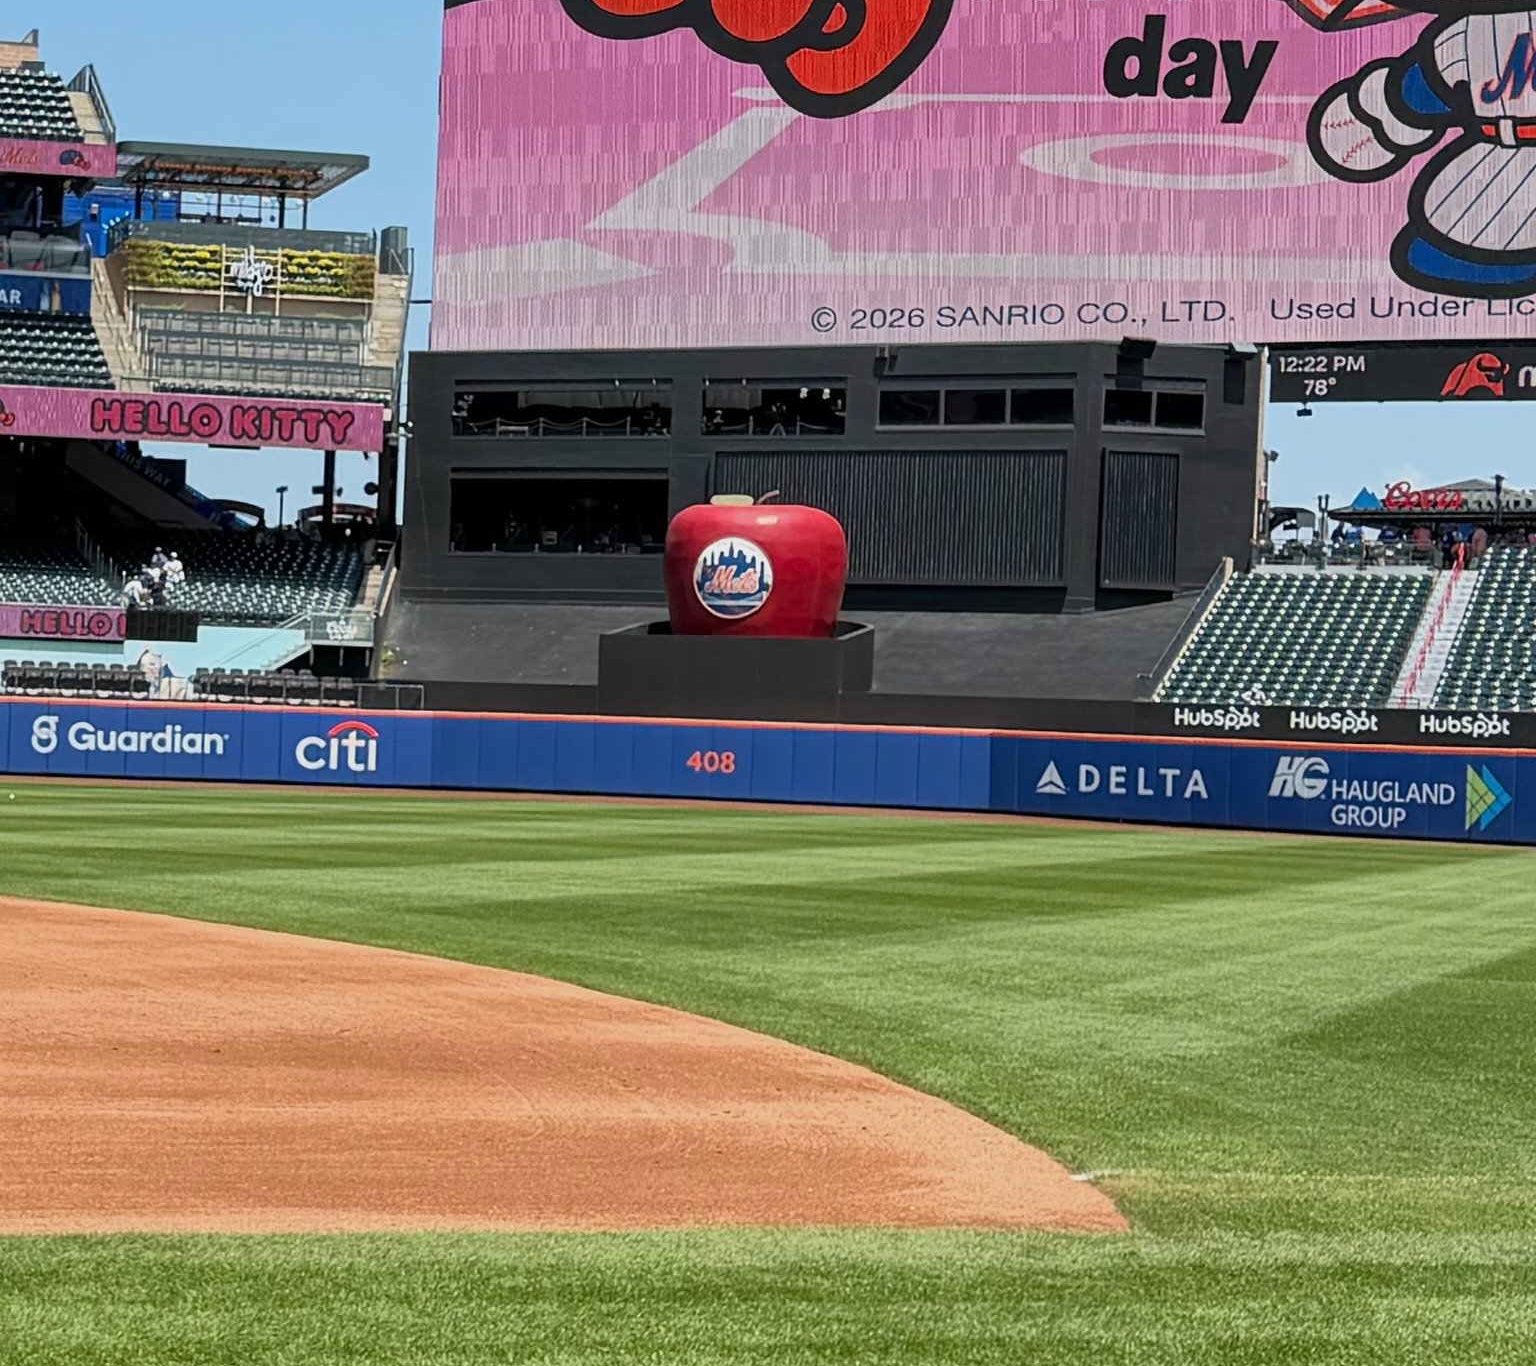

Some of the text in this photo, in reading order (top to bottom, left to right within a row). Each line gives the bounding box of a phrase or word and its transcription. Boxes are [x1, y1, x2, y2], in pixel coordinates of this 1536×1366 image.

[1103, 15, 1279, 124] day
[850, 308, 925, 330] 2026
[935, 303, 1065, 328] SANRIO
[1076, 302, 1148, 327] CO.,
[1161, 300, 1236, 323] LTD.
[1270, 297, 1356, 320] Used
[1370, 295, 1476, 319] Under
[1279, 355, 1366, 373] 12:22 PM
[91, 398, 354, 444] HELLO KITTY
[20, 609, 112, 636] HELLO
[1175, 706, 1261, 731] HubSpot
[1290, 709, 1378, 734] HubSpot
[1419, 713, 1510, 738] HubSpot
[68, 721, 224, 756] Guardian
[295, 729, 378, 772] citi
[686, 750, 736, 774] 408
[1078, 764, 1208, 800] DELTA
[1331, 778, 1456, 806] HAUGLAND
[1331, 805, 1406, 829] GROUP
